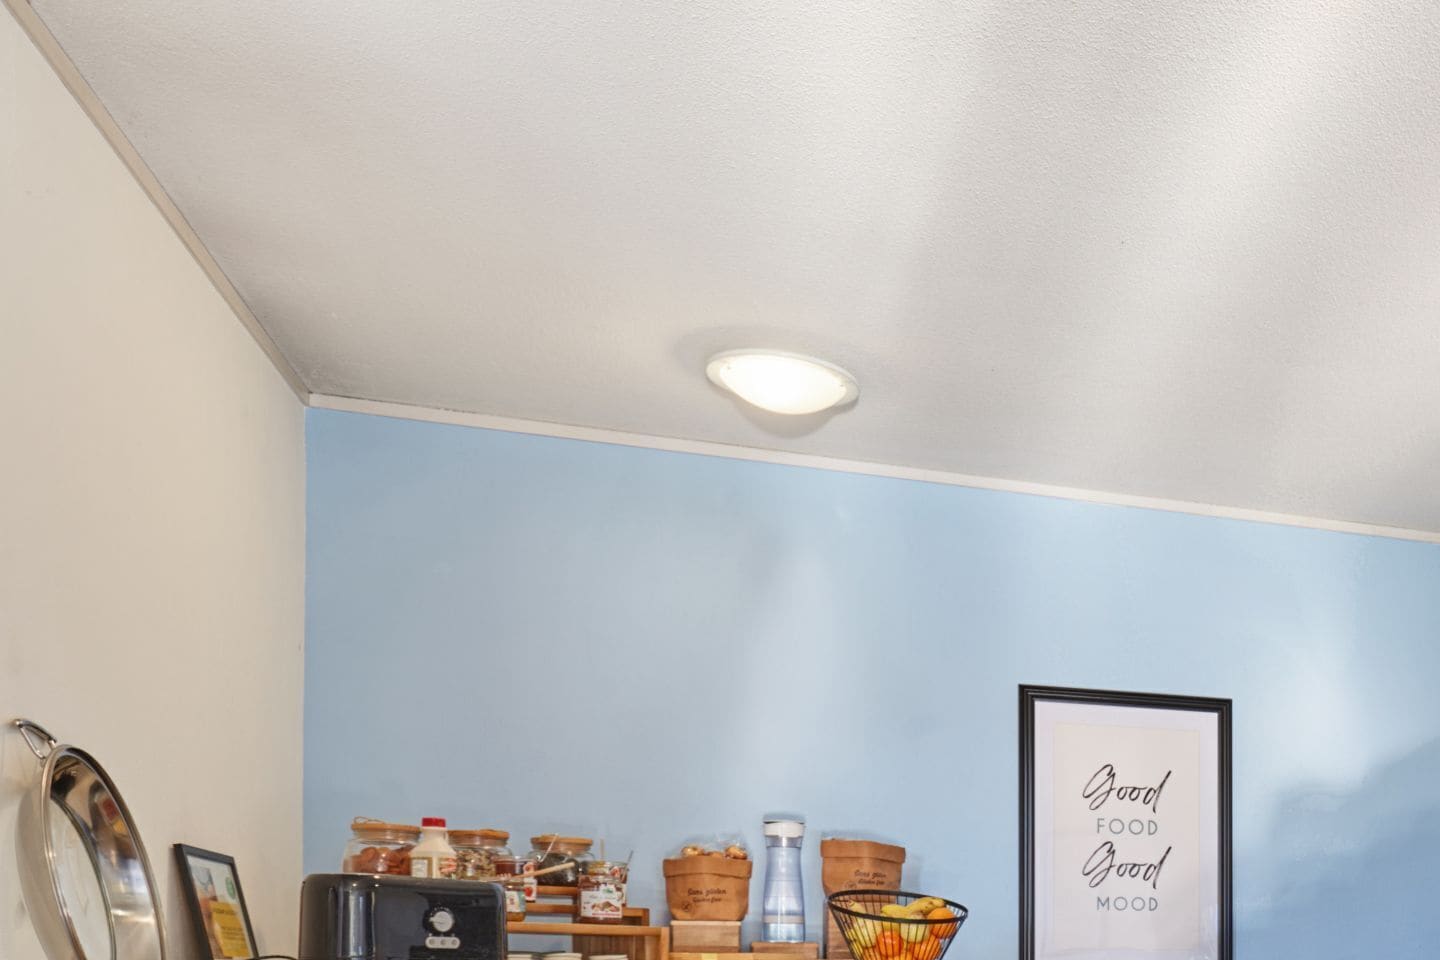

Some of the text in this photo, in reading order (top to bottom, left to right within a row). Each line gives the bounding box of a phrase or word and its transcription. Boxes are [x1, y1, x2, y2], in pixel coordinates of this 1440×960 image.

[1082, 763, 1172, 813] Good
[1096, 818, 1159, 836] FOOD
[1082, 840, 1172, 889] Good
[1096, 896, 1159, 912] MOOD
